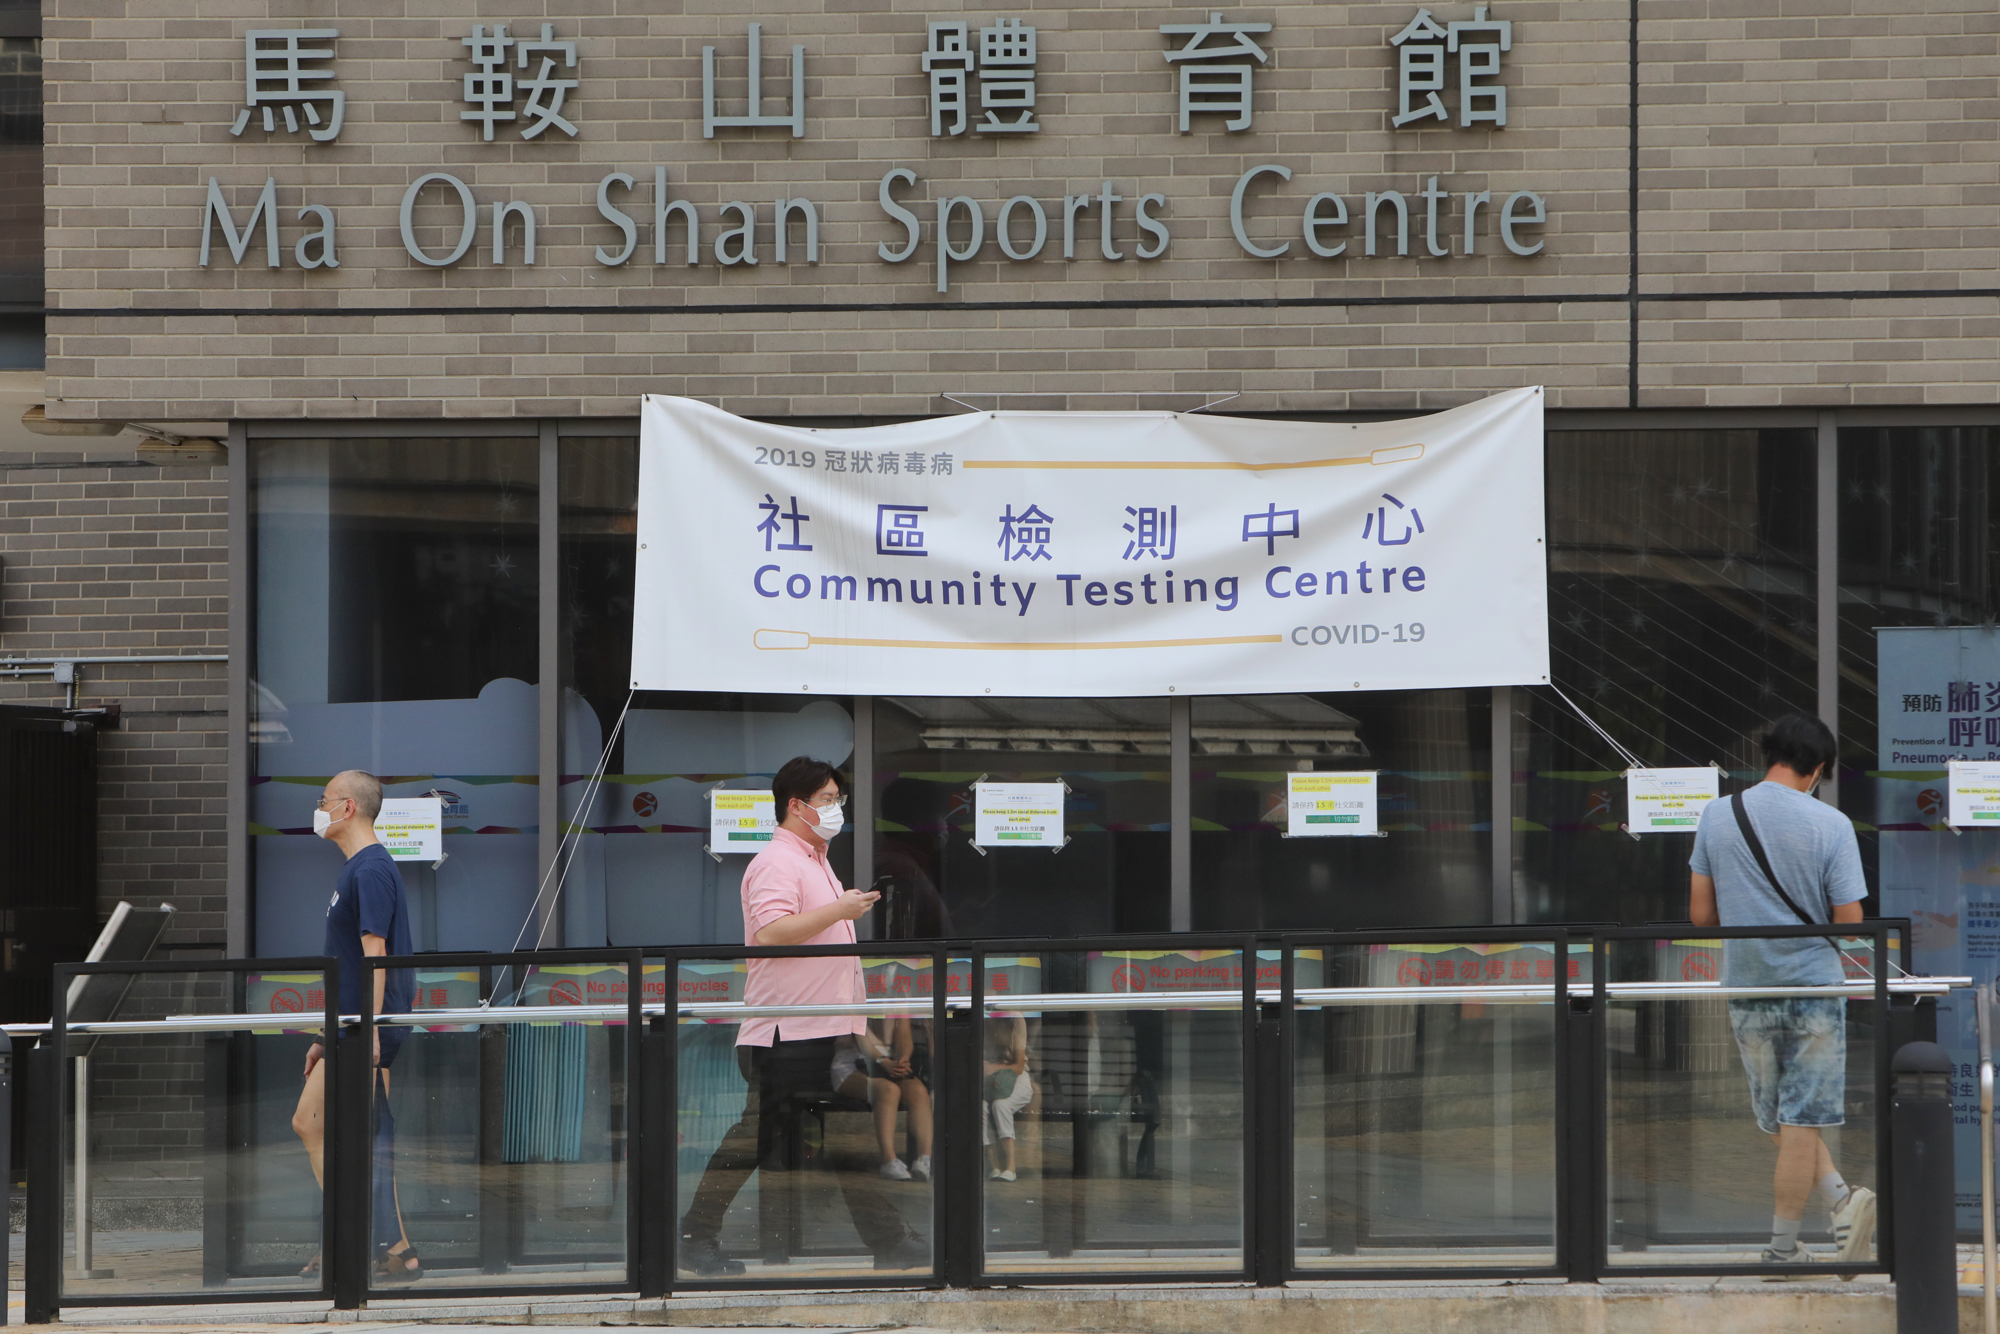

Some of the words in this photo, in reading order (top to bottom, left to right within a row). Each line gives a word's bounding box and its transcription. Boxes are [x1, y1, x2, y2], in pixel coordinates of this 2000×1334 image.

[230, 5, 1512, 143] 馬鞍山體育館
[199, 176, 340, 270] Ma
[400, 172, 537, 268] On
[595, 166, 818, 267] Shan
[877, 167, 1170, 293] Sports
[1229, 164, 1546, 258] Centre
[754, 446, 816, 468] 2019
[824, 450, 954, 476] 冠狀病毒病
[756, 492, 1425, 562] 社區檢測中心
[753, 564, 1037, 616] Community
[1057, 570, 1239, 611] Testing
[1265, 560, 1427, 599] Centre
[1291, 622, 1426, 646] COVID-19
[1902, 694, 1942, 712] 預防
[1892, 737, 1936, 746] Prevention
[1937, 737, 1946, 746] of
[1150, 965, 1170, 978] No
[1175, 965, 1229, 980] parking
[1435, 959, 1581, 979] 請勿停放單車
[587, 980, 607, 993] No
[611, 979, 666, 995] paing
[678, 979, 729, 995] icycles
[867, 973, 1010, 993] 請勿停放車
[1955, 1115, 1968, 1124] tal
